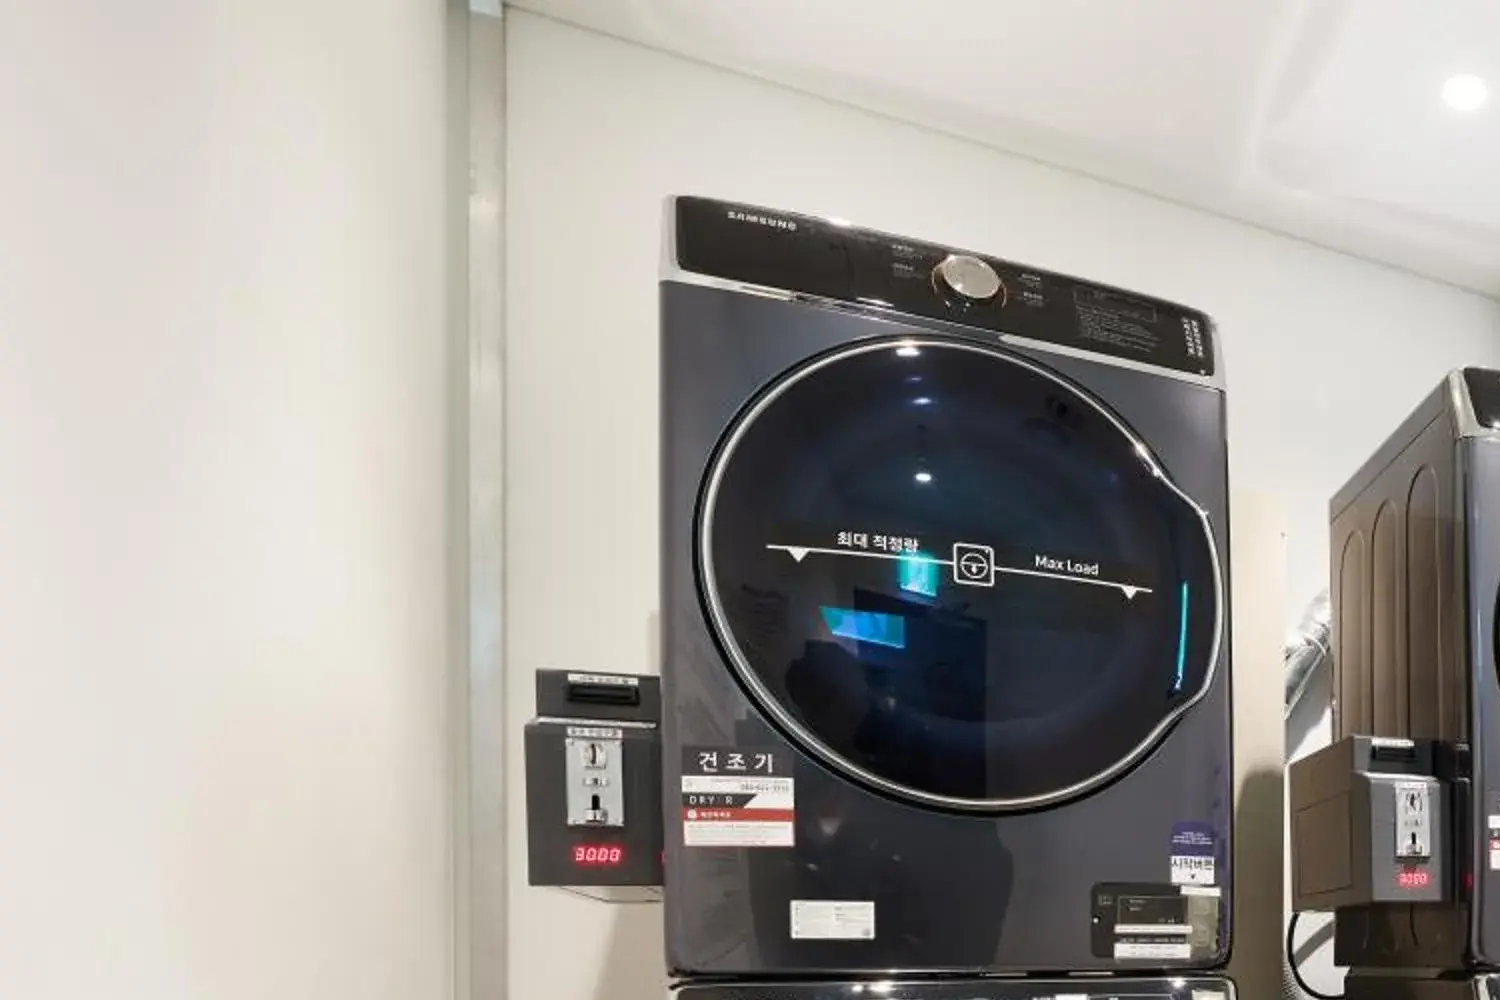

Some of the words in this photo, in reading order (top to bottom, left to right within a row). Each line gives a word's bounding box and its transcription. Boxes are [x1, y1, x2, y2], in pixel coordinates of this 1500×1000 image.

[728, 209, 797, 231] SAMSUNG
[837, 530, 869, 550] 최대
[1035, 554, 1065, 573] Max
[1067, 558, 1099, 576] Load
